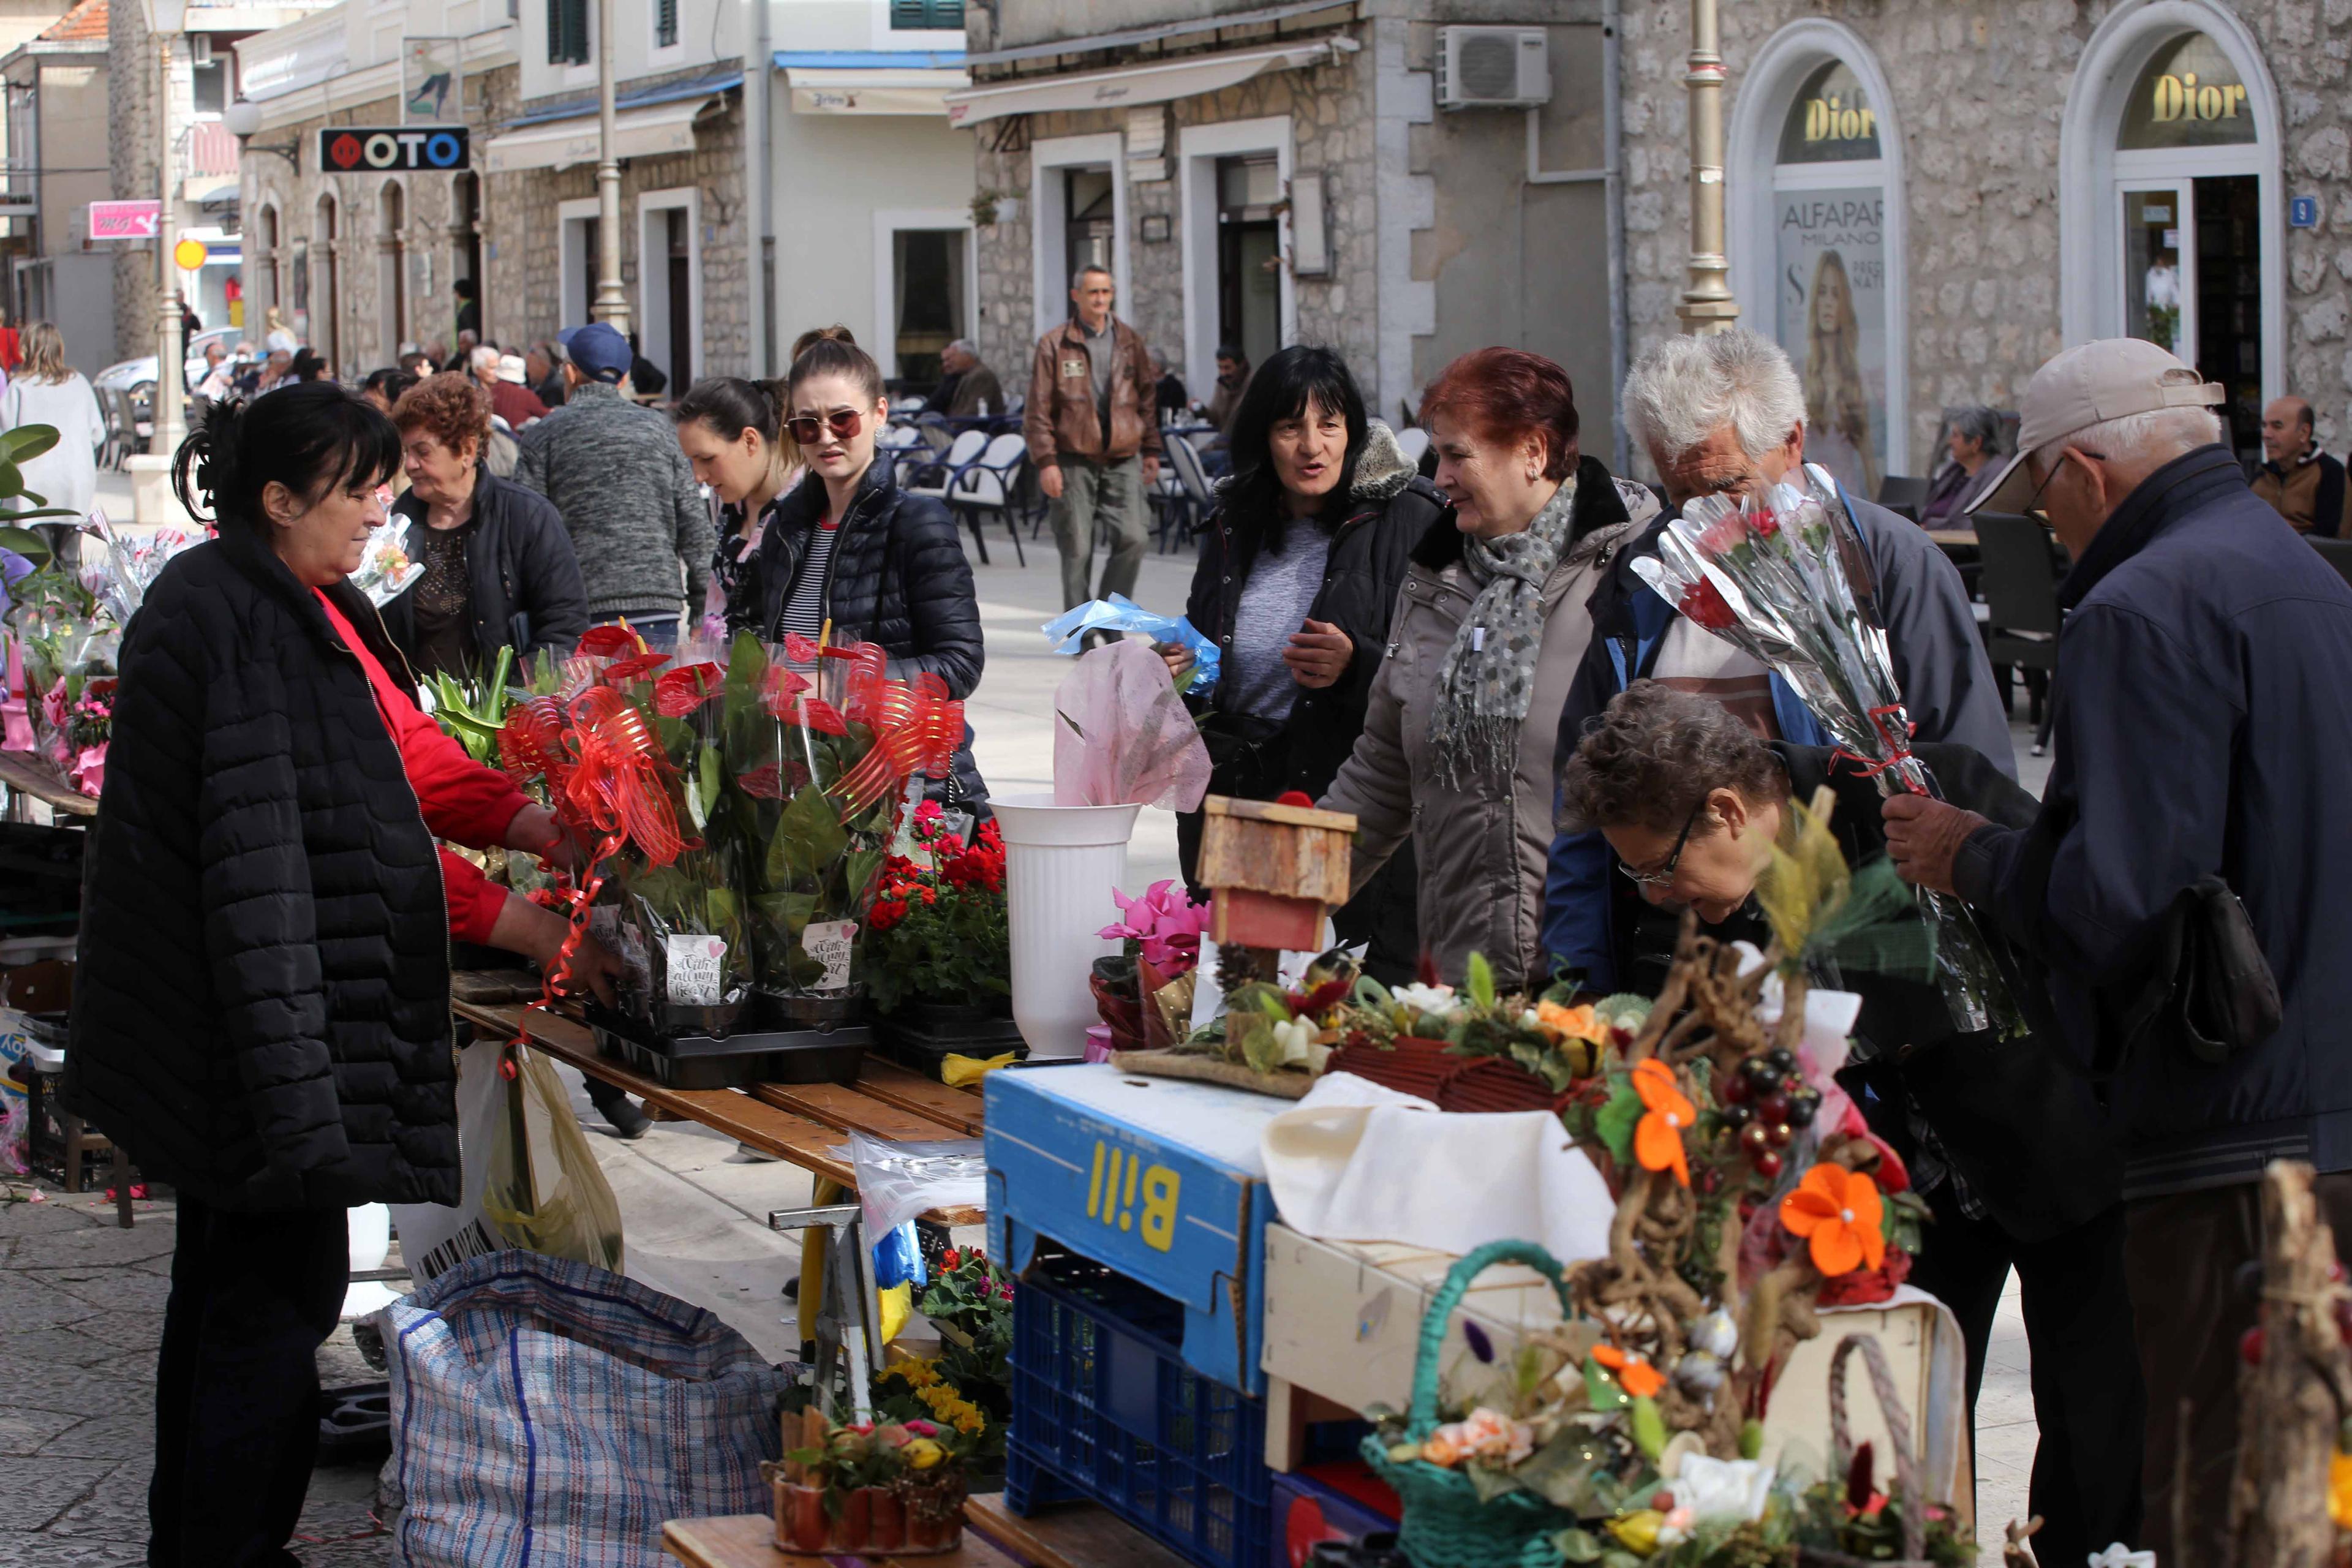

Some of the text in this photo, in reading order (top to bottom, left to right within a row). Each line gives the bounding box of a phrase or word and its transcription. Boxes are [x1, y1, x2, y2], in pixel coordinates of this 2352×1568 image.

[1804, 95, 1875, 141] Dior
[2152, 72, 2245, 121] Dior
[331, 133, 459, 168] ФОТО
[1801, 231, 1881, 246] MILANO
[1087, 1140, 1180, 1252] Bill
